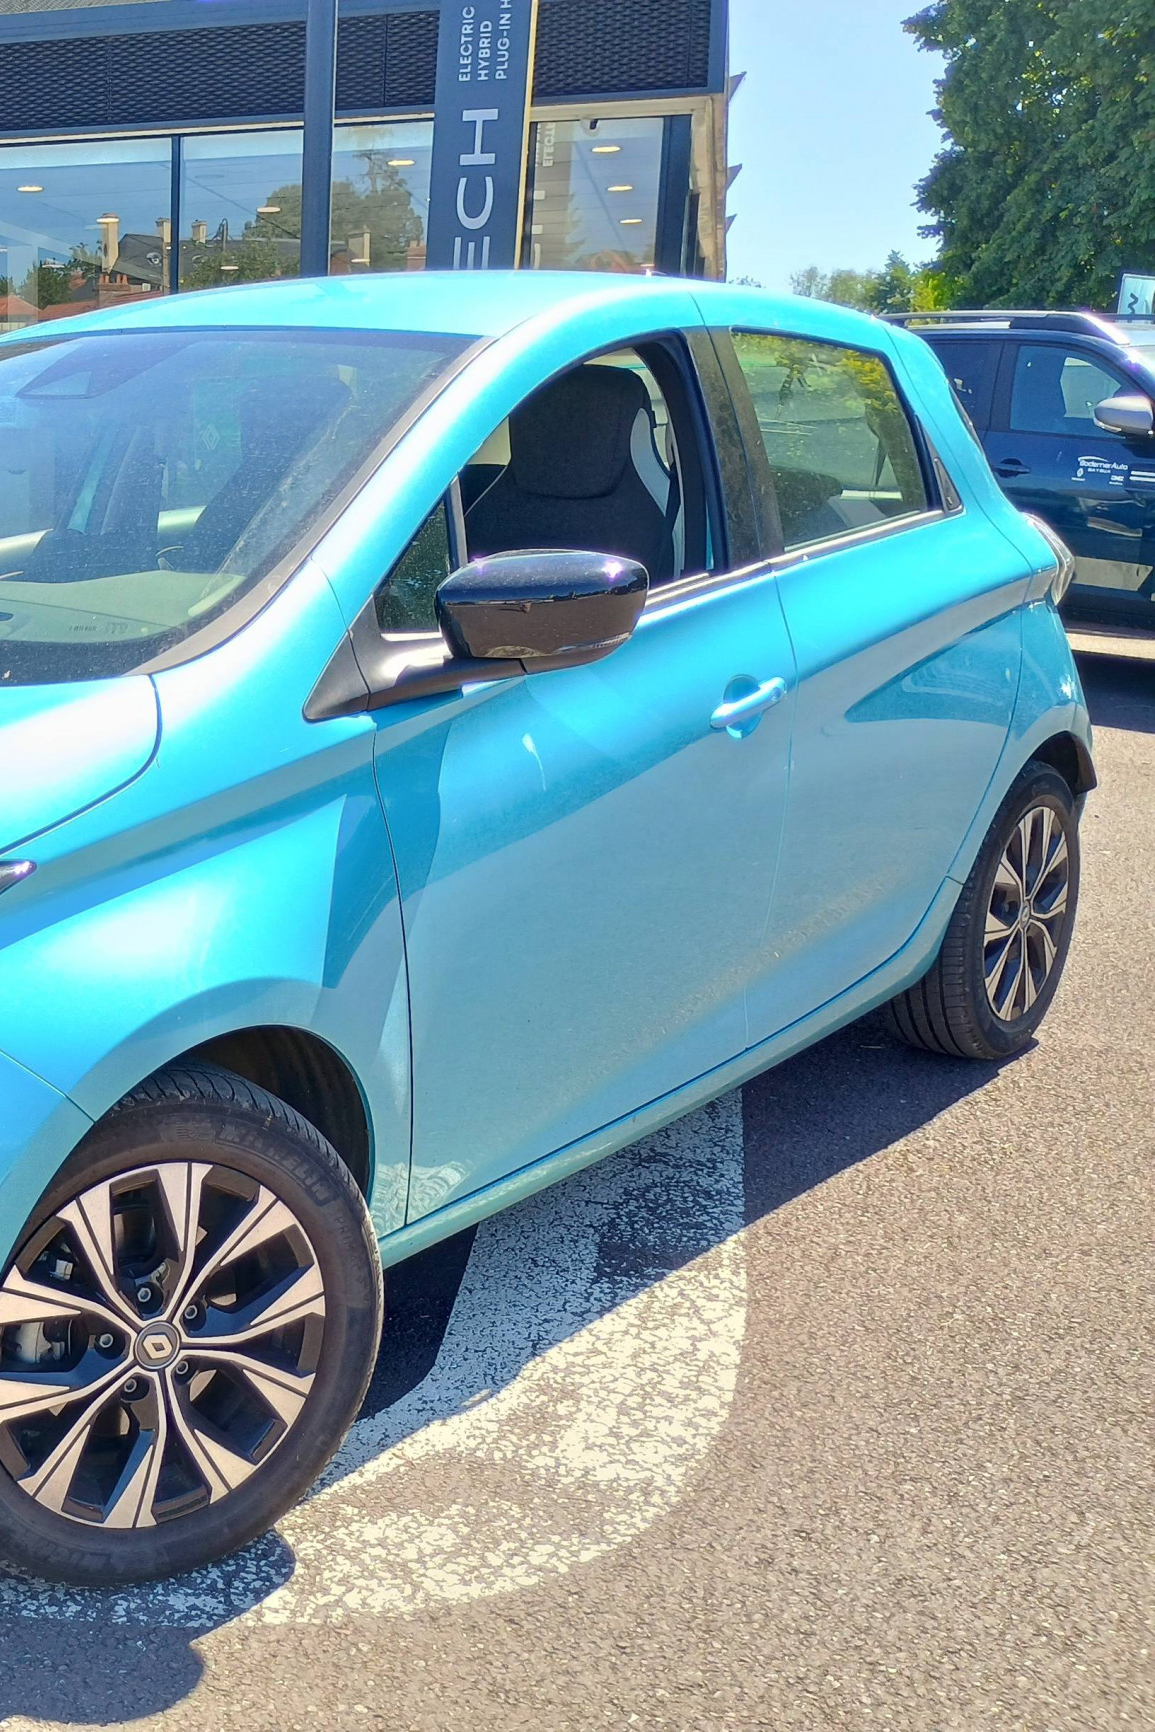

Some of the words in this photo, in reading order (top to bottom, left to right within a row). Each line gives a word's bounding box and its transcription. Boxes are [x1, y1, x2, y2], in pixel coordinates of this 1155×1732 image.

[458, 5, 475, 82] ELECTRIC
[477, 20, 493, 81] HYBRID
[495, 13, 511, 80] PLUG-IN
